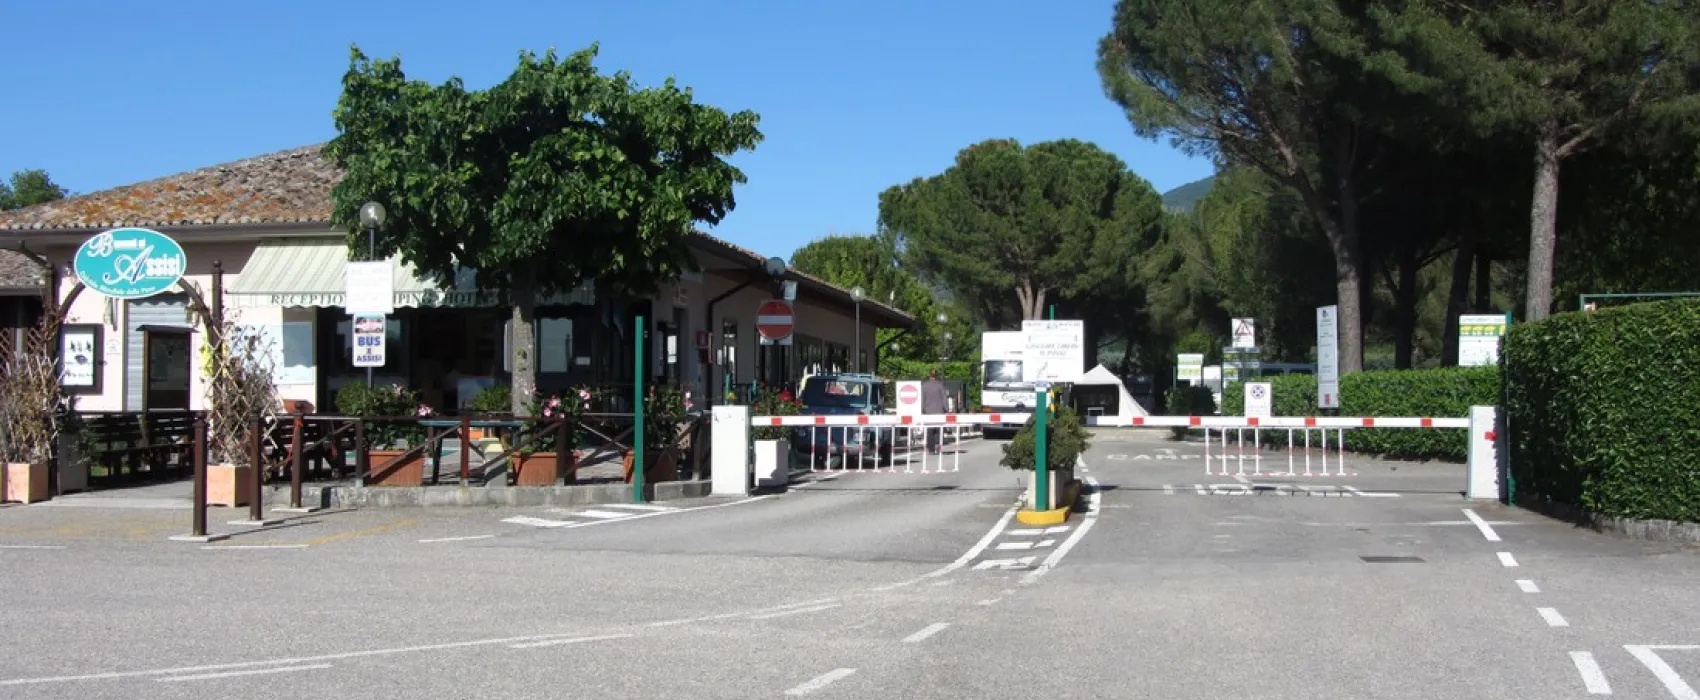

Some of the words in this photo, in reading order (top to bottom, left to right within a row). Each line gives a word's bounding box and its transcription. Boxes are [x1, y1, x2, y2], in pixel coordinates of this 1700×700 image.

[271, 293, 345, 304] RECEPTIO
[357, 336, 381, 347] BUS
[356, 355, 382, 363] ASSISI
